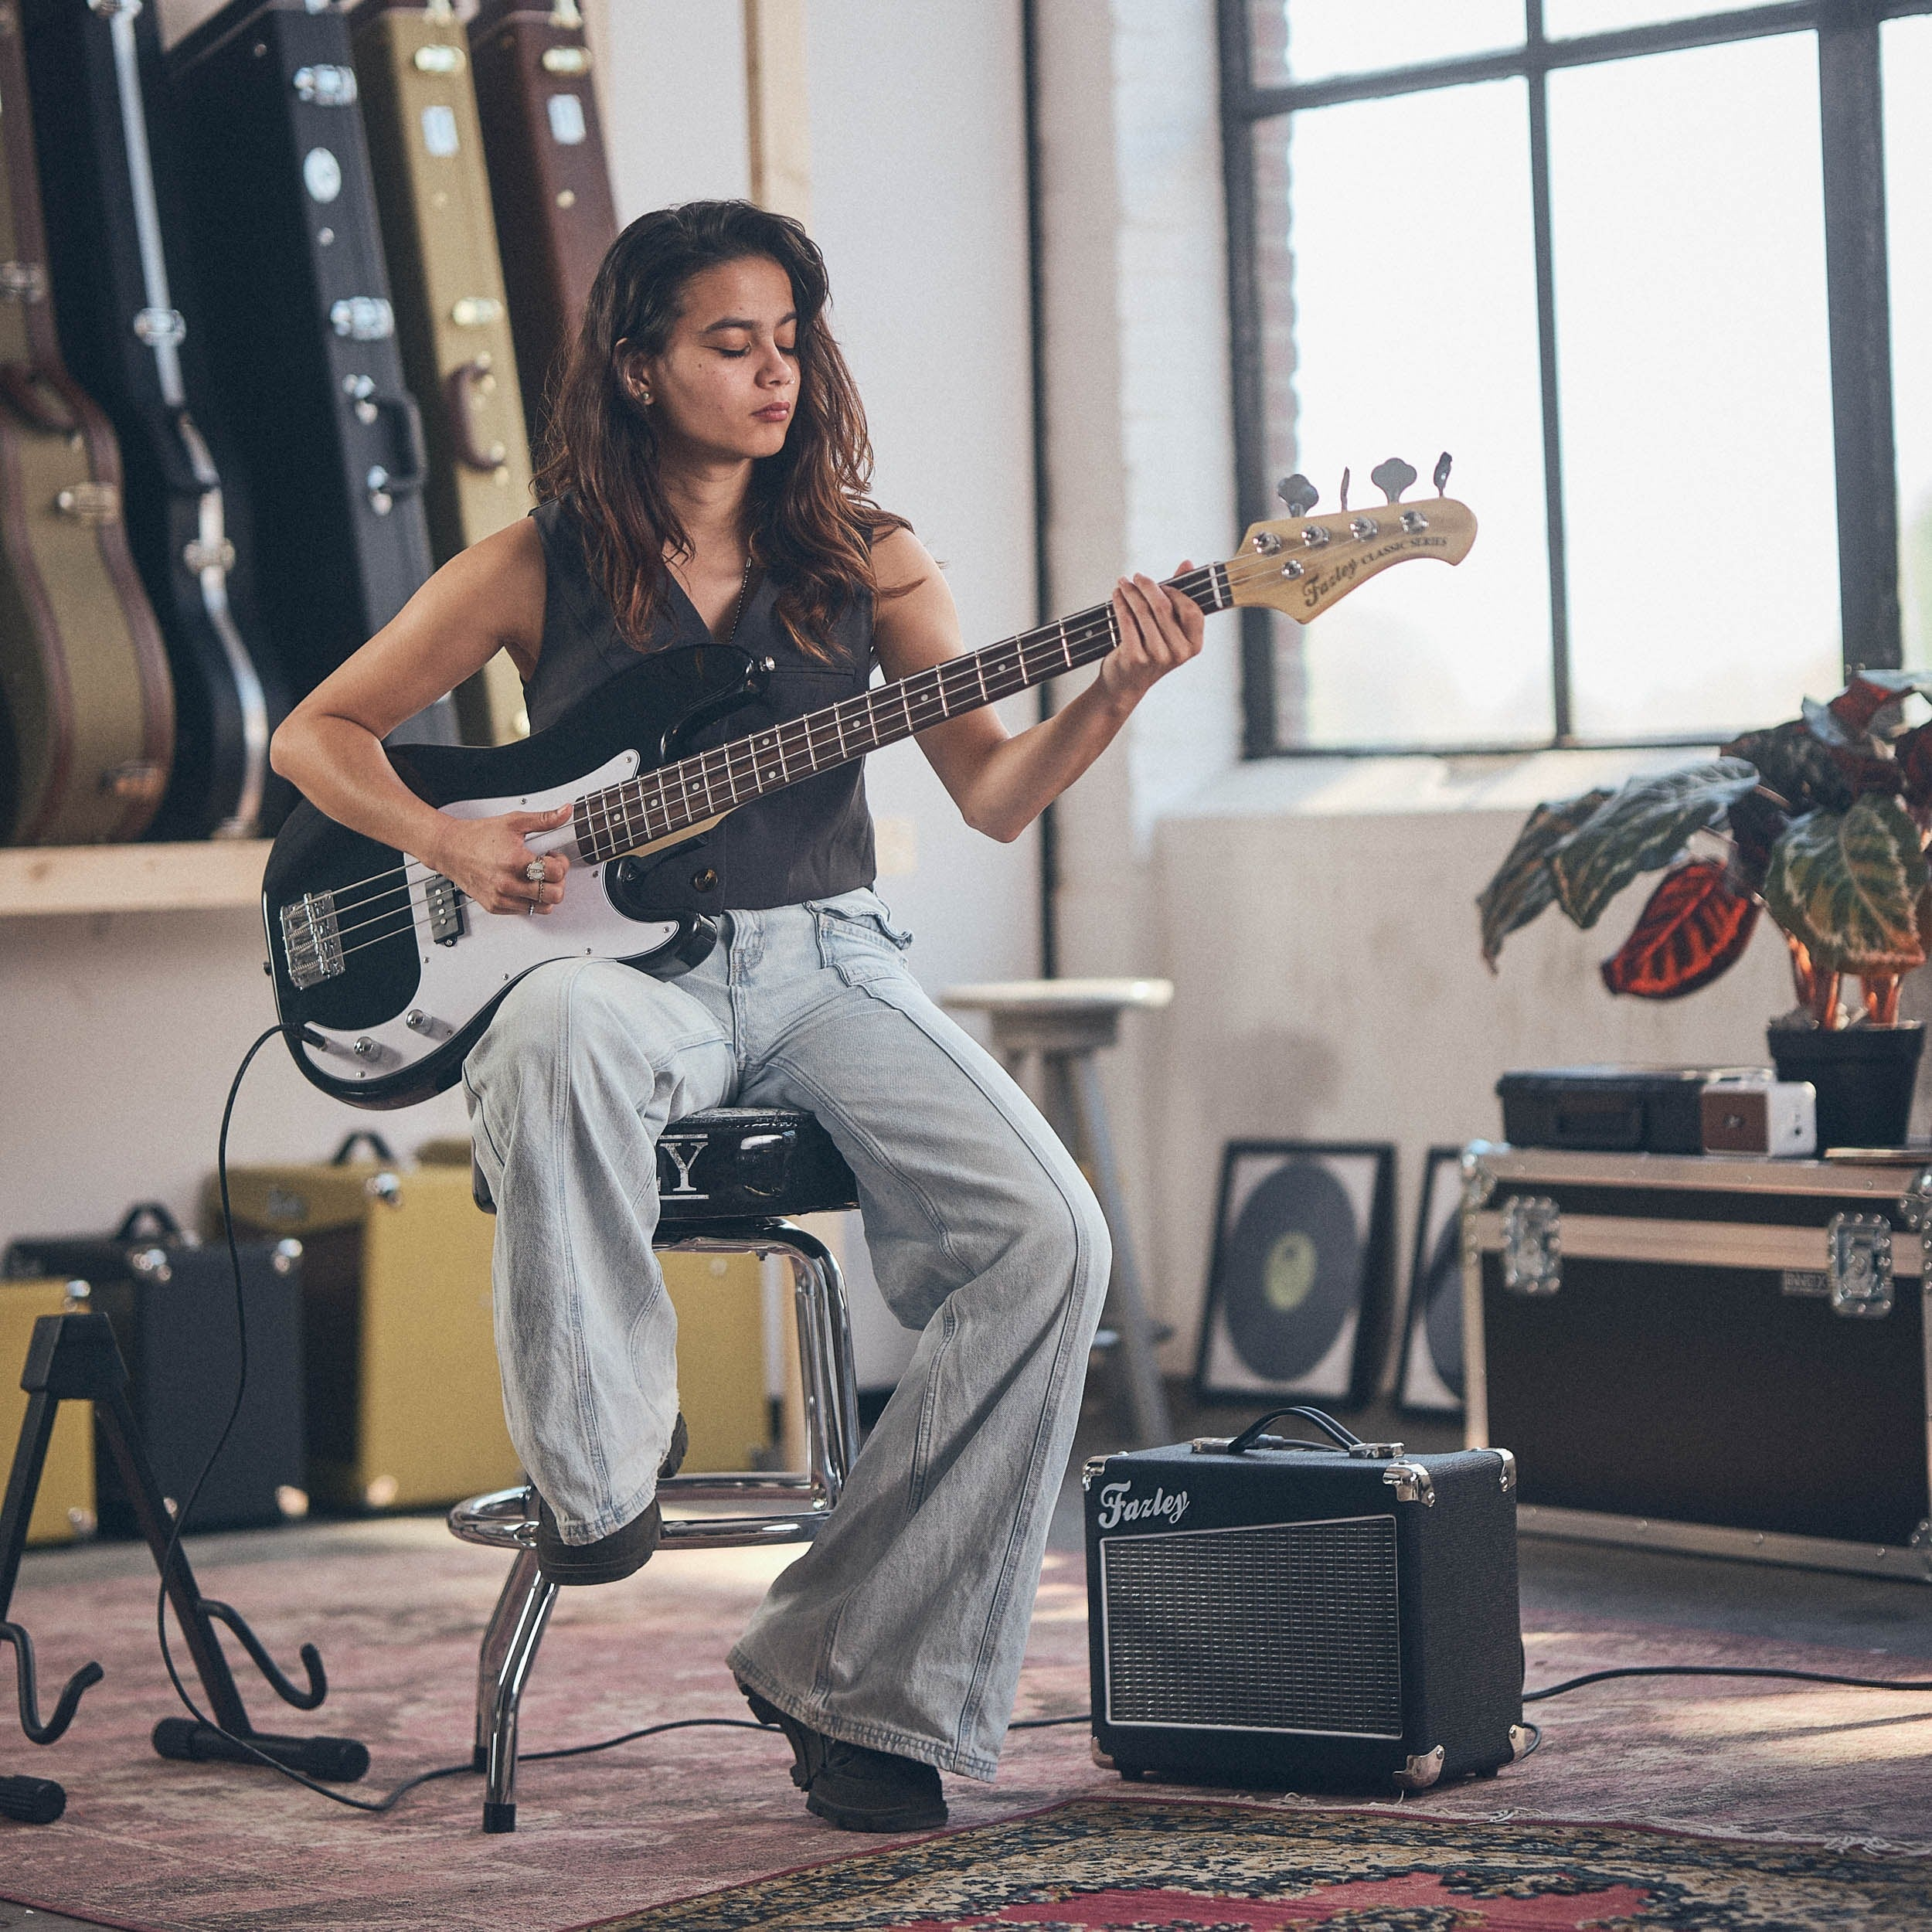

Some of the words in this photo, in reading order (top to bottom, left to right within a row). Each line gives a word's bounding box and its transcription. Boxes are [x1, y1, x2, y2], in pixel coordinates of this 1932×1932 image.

[1303, 558, 1359, 607] Fazley
[1361, 542, 1404, 565] CLASSIC
[1410, 536, 1447, 547] SERIES
[656, 1141, 709, 1192] Y
[1097, 1479, 1191, 1529] Fazley
